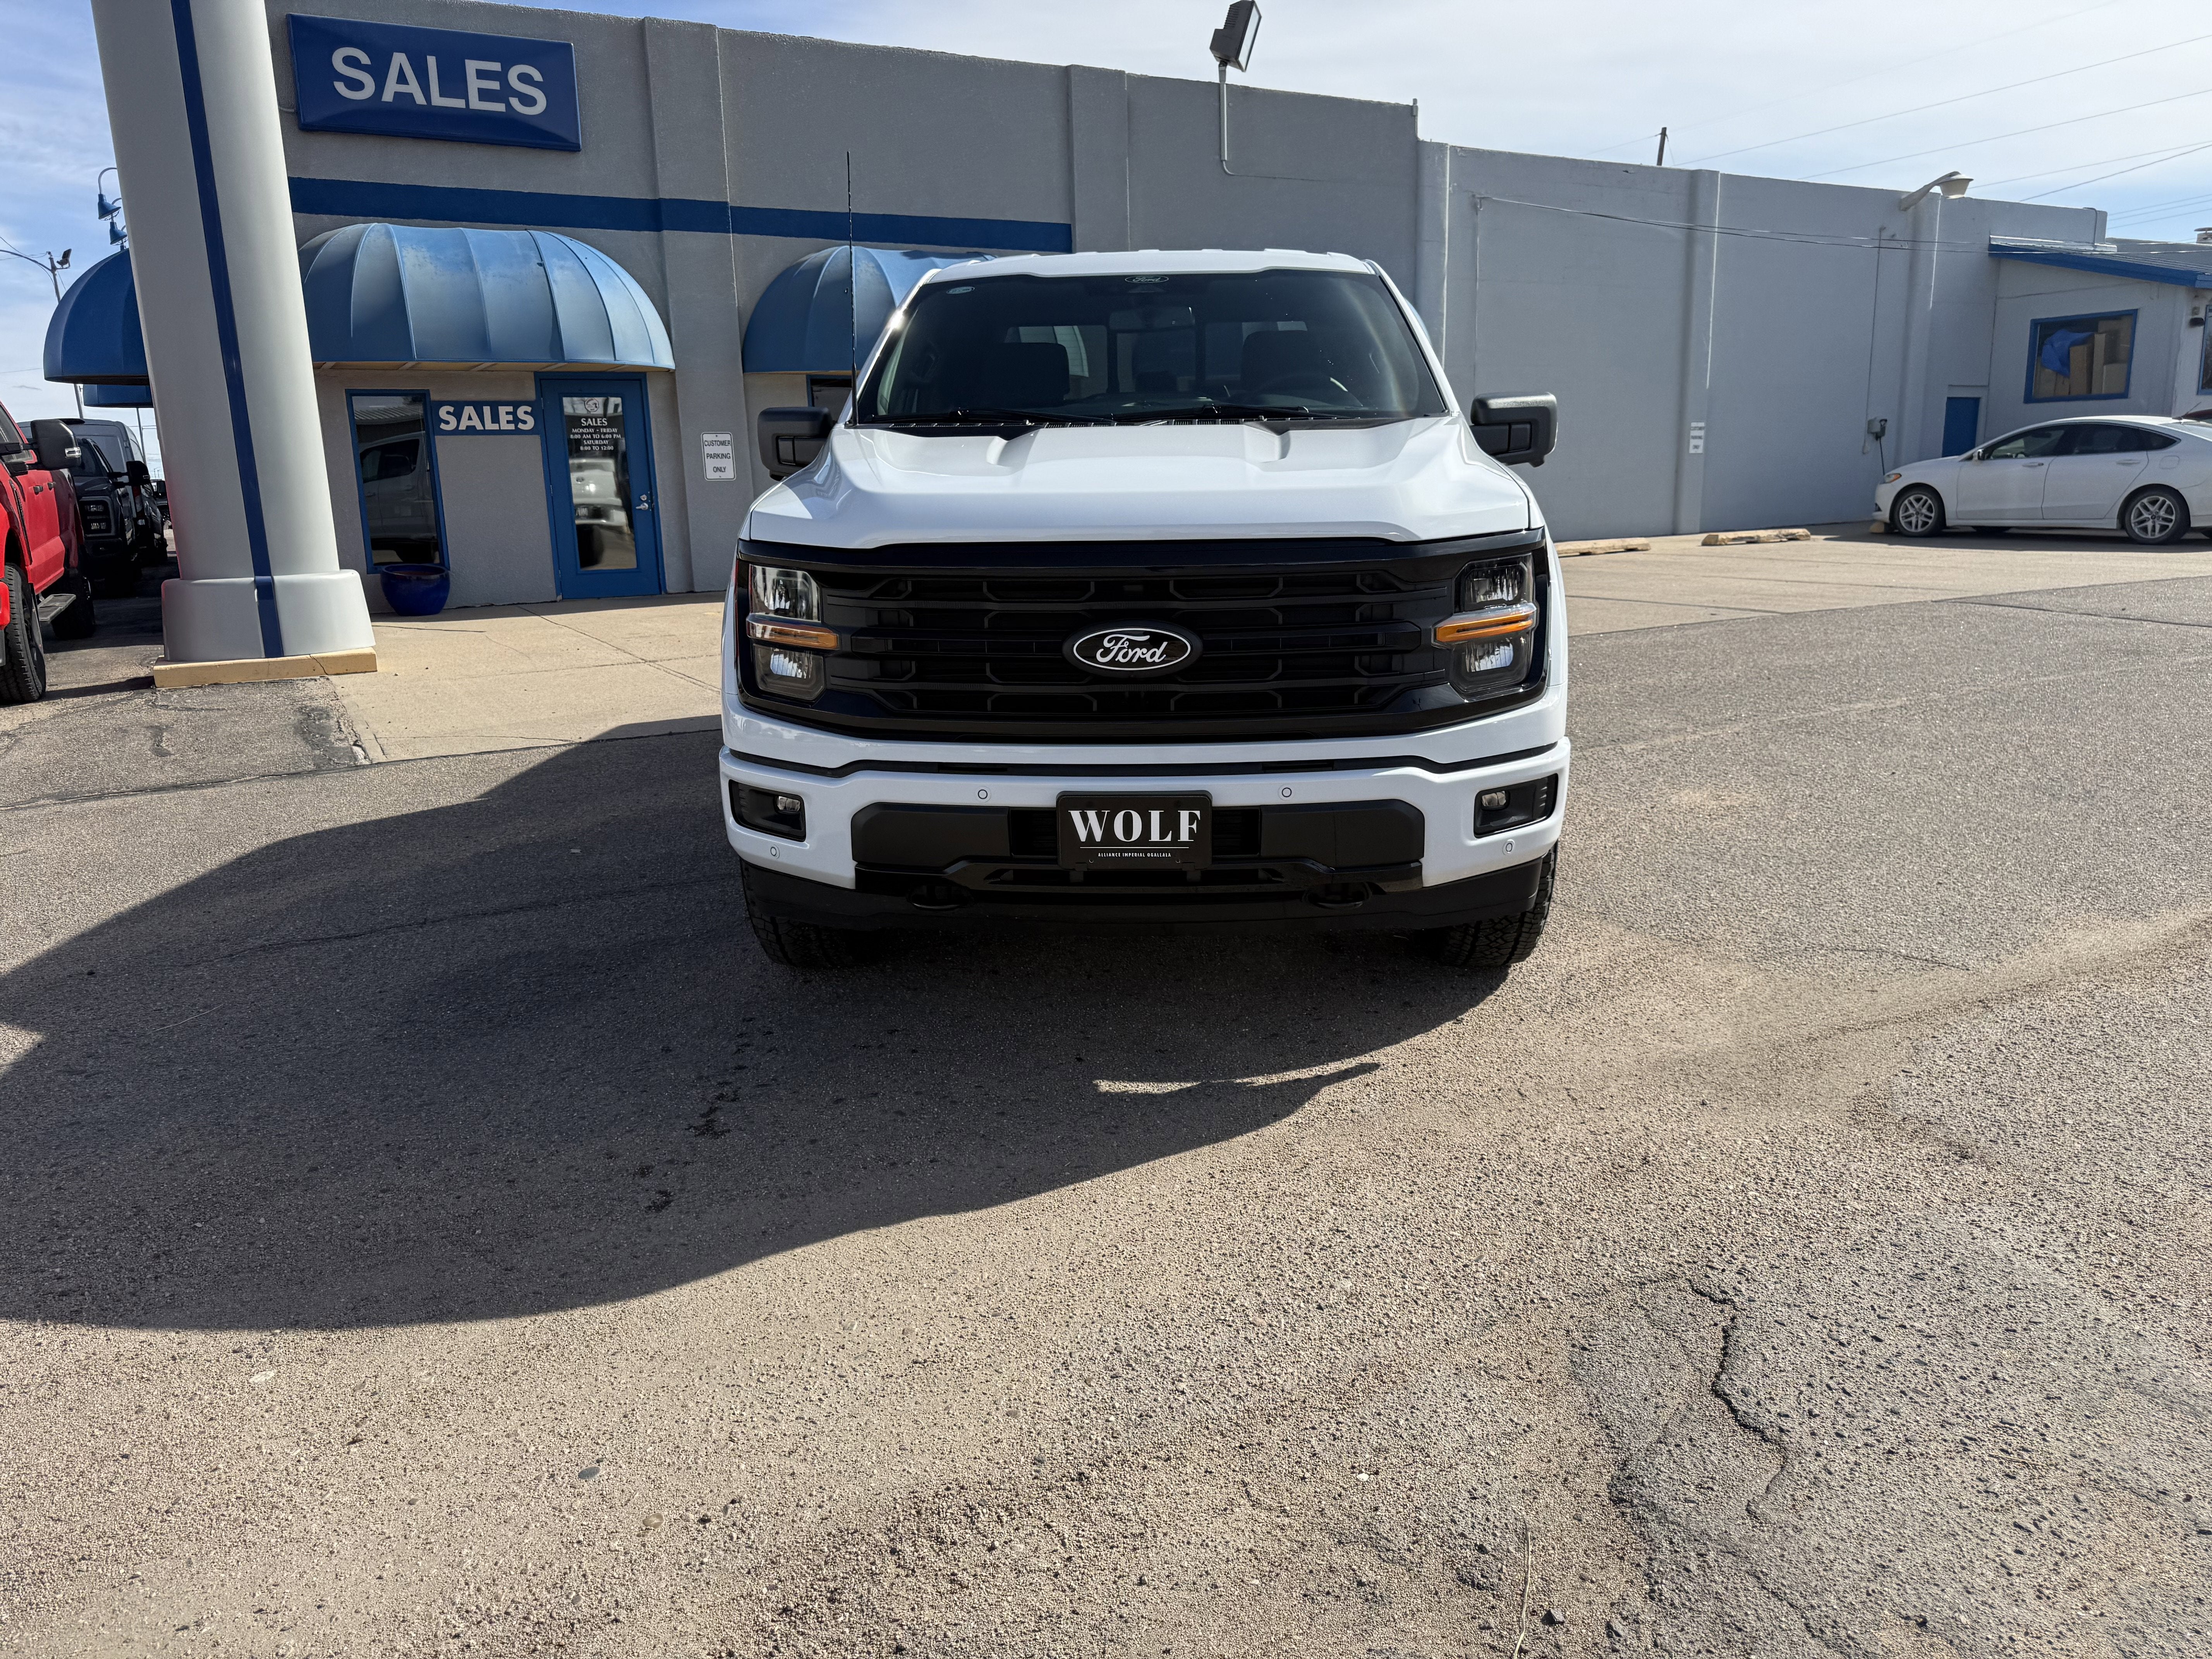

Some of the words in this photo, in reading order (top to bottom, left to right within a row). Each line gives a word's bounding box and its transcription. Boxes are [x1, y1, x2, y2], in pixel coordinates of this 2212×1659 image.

[331, 47, 547, 115] SALES
[438, 405, 534, 431] SALES
[581, 418, 608, 426] SALES
[1096, 634, 1168, 663] Ford
[1068, 810, 1200, 842] WOLF
